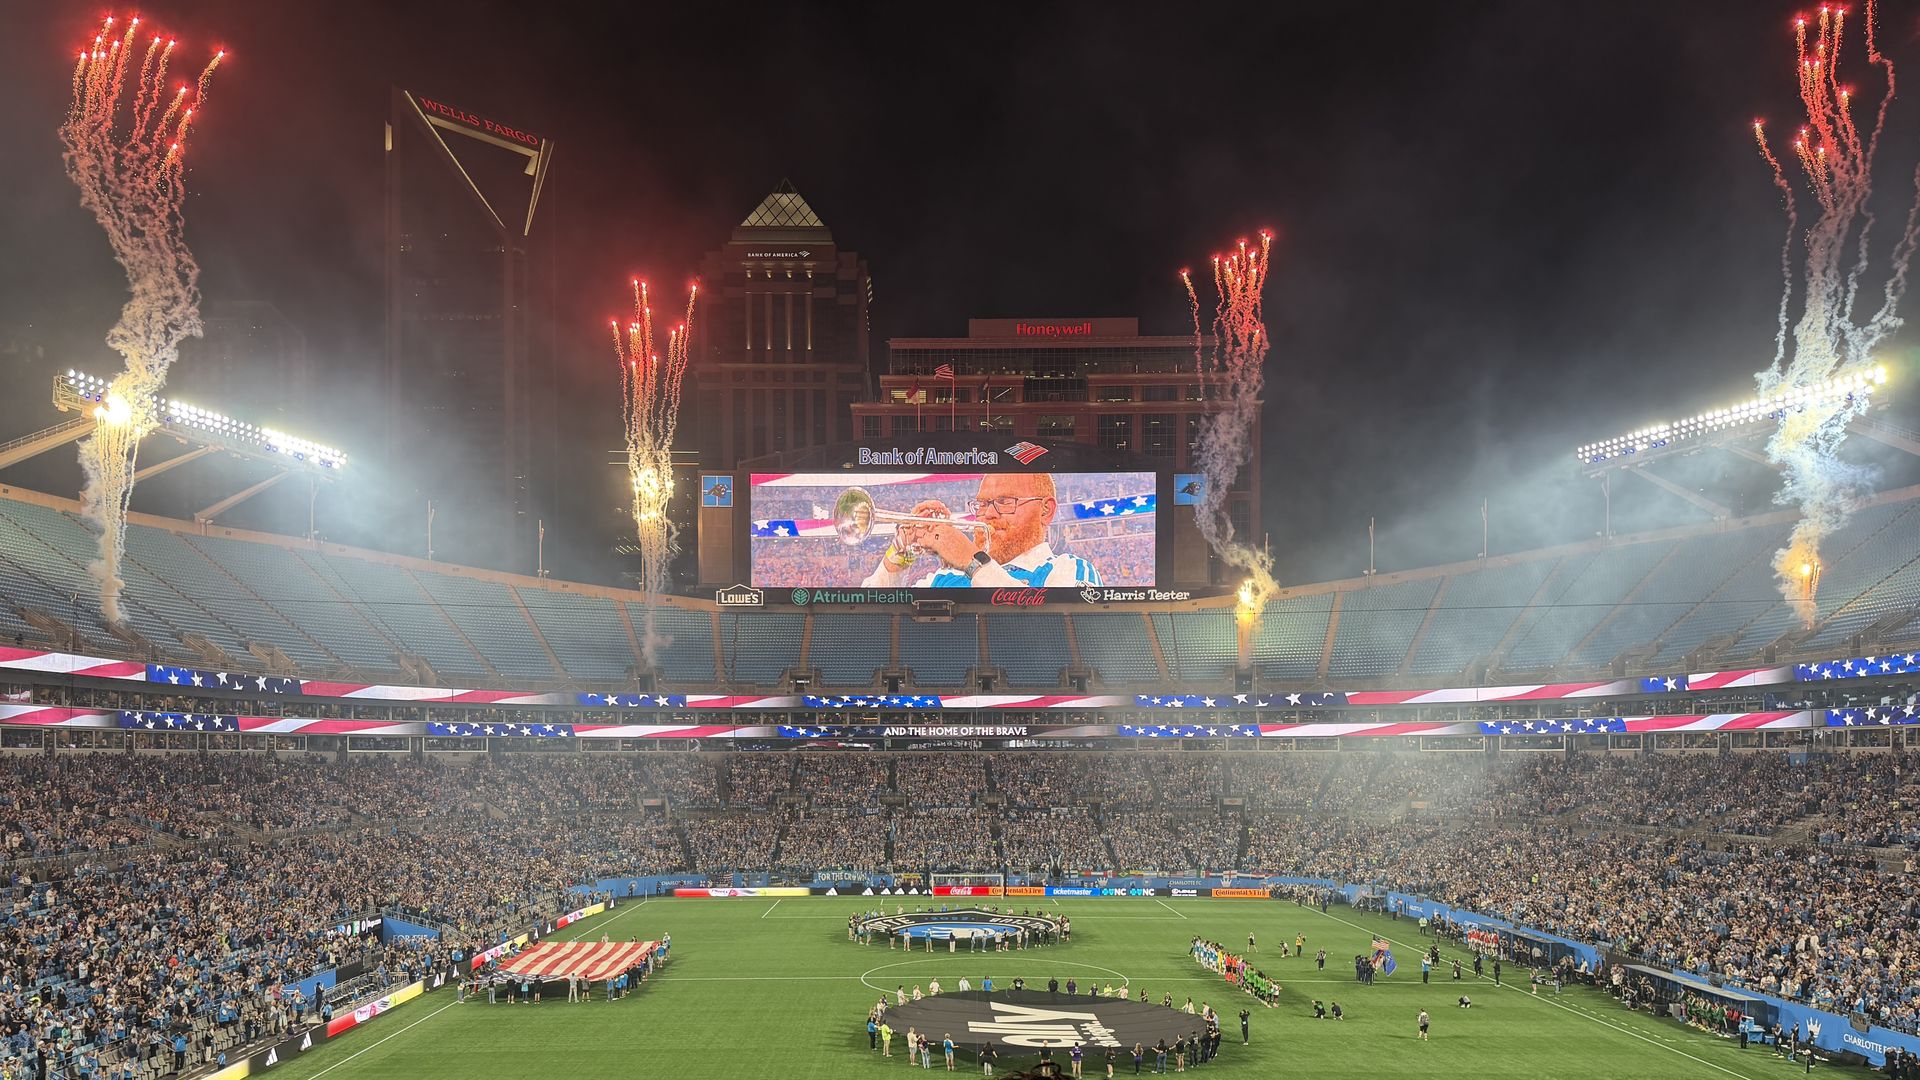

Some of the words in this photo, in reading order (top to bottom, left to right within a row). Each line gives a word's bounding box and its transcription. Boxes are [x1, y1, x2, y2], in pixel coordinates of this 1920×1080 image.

[420, 97, 480, 126] WELLS
[485, 119, 538, 145] FARGO
[1016, 322, 1091, 336] Honeywell
[858, 447, 903, 465] Bank
[904, 447, 924, 465] of
[925, 447, 999, 465] America
[721, 592, 760, 604] LOWE'S
[812, 589, 865, 603] Atrium
[867, 588, 914, 603] Health
[1103, 589, 1146, 601] Harris
[1147, 589, 1190, 601] Teeter
[884, 727, 907, 736] AND
[907, 727, 926, 736] THE
[928, 727, 958, 736] HOME
[961, 727, 975, 736] OF
[975, 727, 995, 736] THE
[996, 727, 1028, 736] BRAVE
[819, 871, 831, 881] FOR
[832, 871, 844, 880] THE
[1114, 888, 1127, 896] NC
[1142, 888, 1155, 896] NC
[967, 1001, 1098, 1048] ally
[1843, 1033, 1883, 1054] CHARLOTTE
